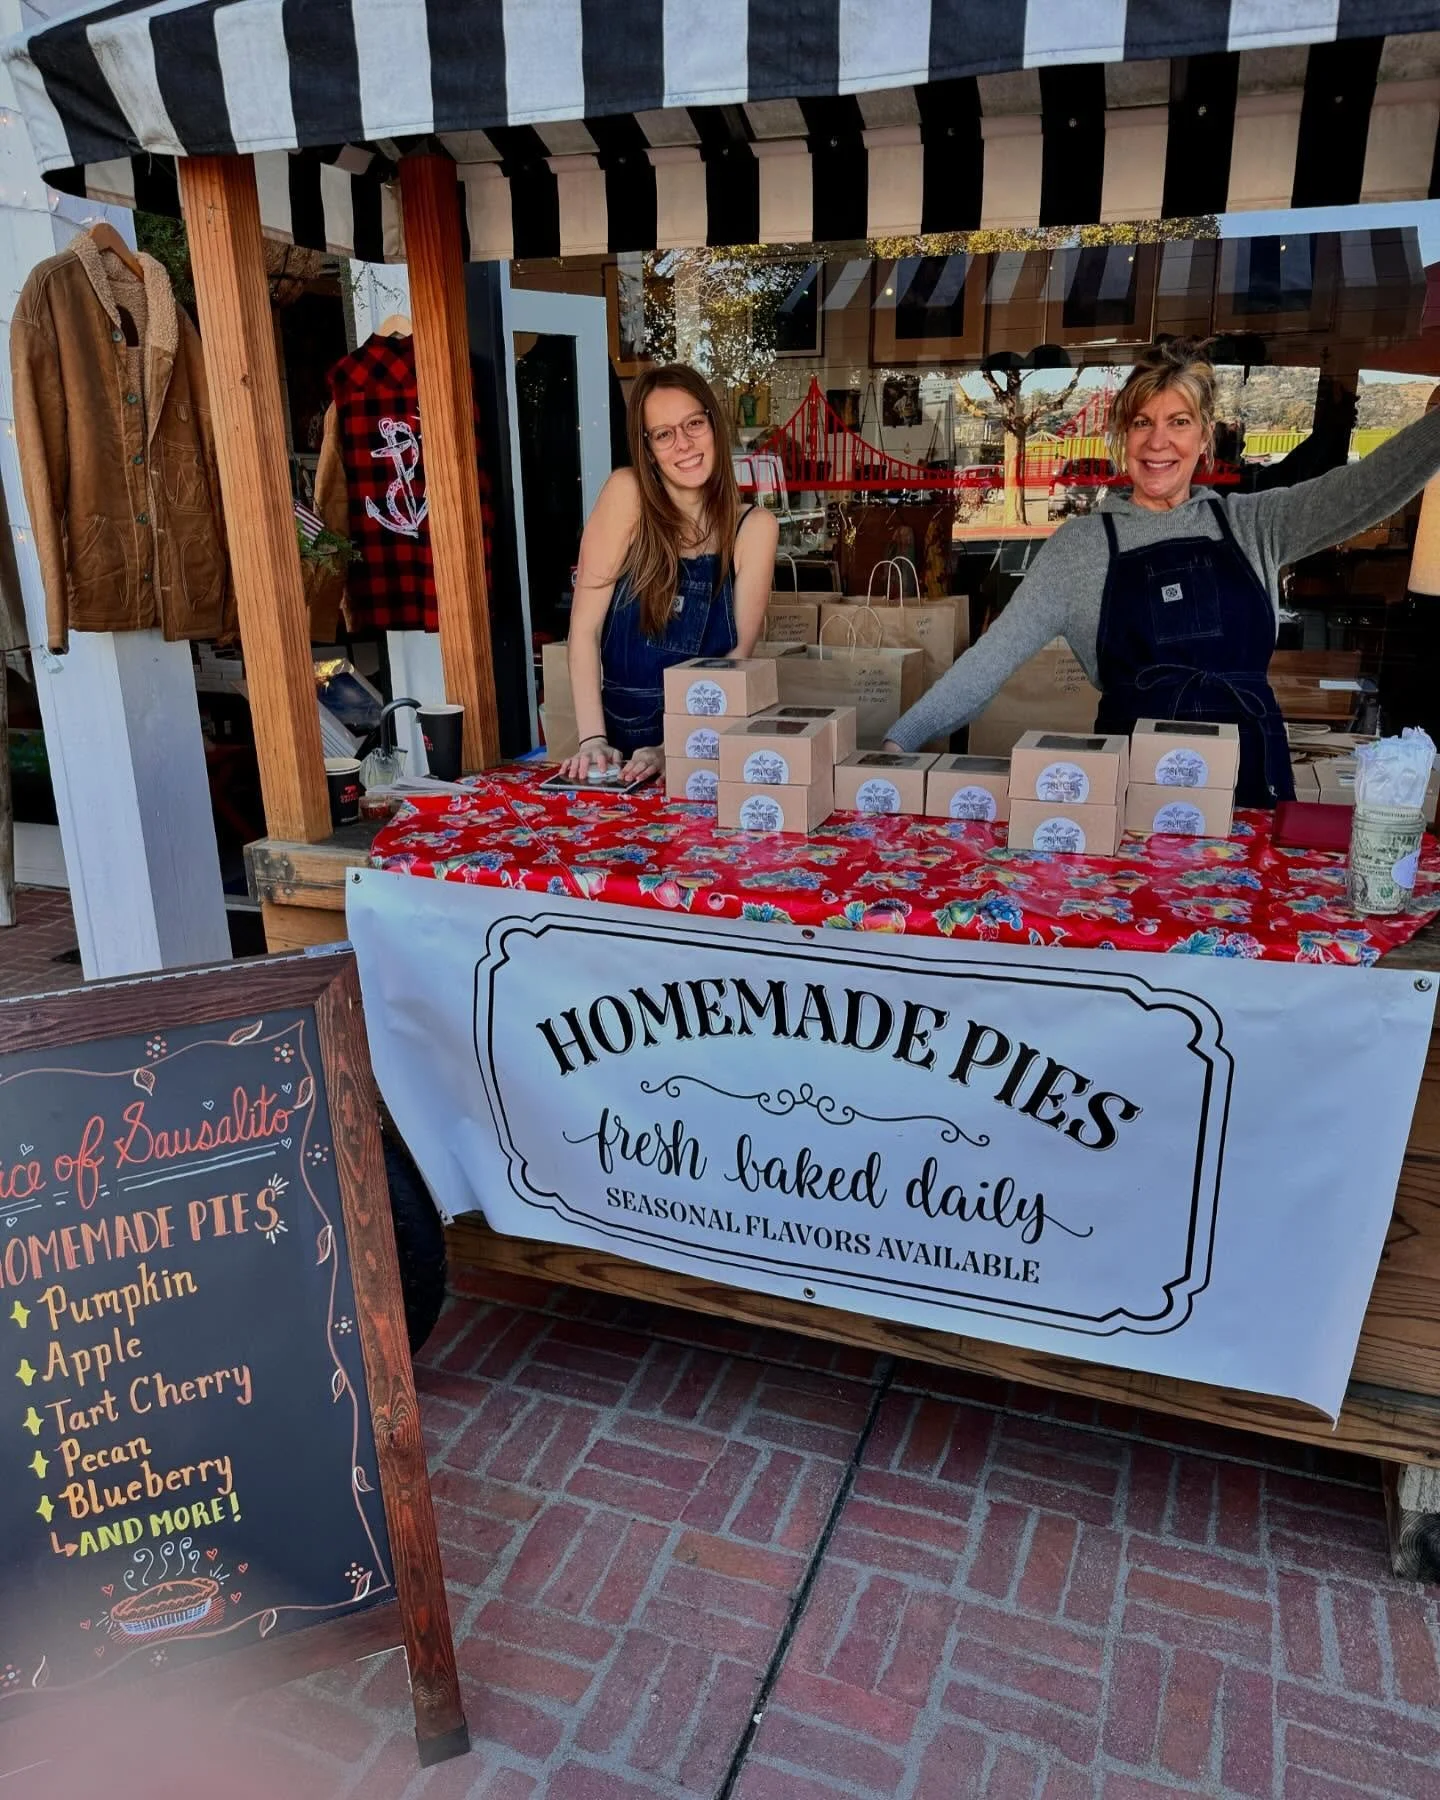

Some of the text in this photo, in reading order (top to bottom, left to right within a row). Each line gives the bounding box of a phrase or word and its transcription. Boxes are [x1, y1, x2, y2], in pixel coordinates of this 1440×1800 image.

[536, 978, 1143, 1151] HOMEMADE PIES
[55, 1116, 104, 1209] of
[115, 1085, 294, 1168] Sausalito
[563, 1108, 1094, 1244] fresh baked daily
[188, 1187, 279, 1242] PIES
[606, 1187, 1040, 1284] SEASONAL FLAVORS AVAILABLE
[37, 1262, 198, 1331] Pumpkin
[42, 1327, 143, 1386] Apple
[46, 1364, 252, 1435] Tart Cherry
[54, 1437, 152, 1477] Pecan
[59, 1455, 234, 1519] Blueberry
[80, 1492, 242, 1557] AND MORE!
